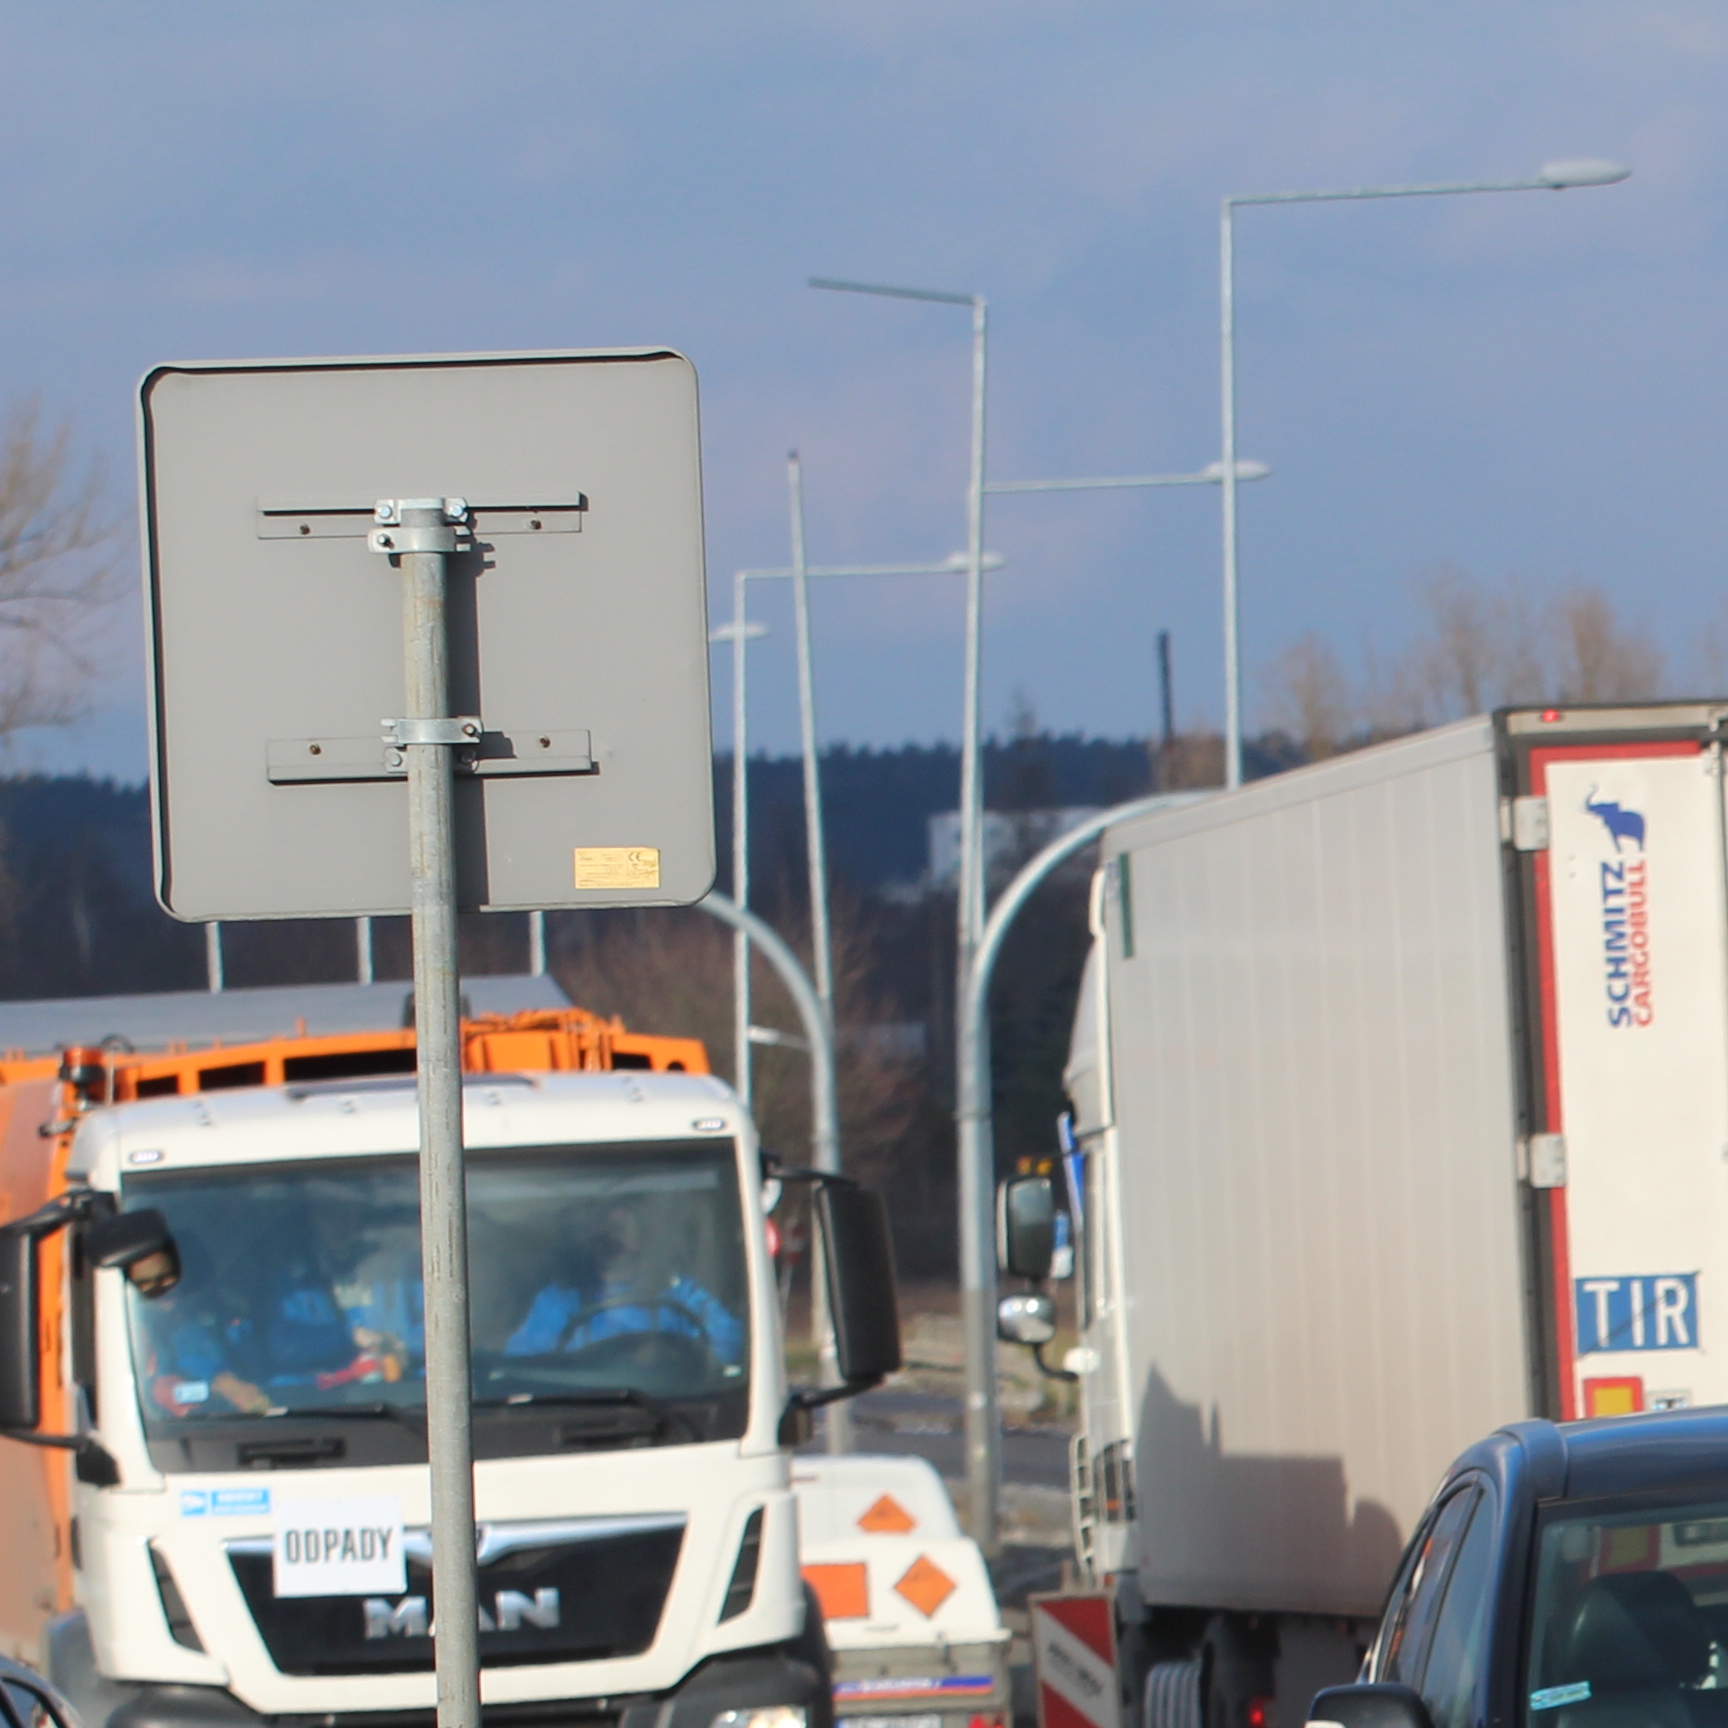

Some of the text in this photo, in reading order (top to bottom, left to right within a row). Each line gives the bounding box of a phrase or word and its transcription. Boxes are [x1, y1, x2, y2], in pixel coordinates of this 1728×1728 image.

[1601, 860, 1632, 1028] SCHMITZ
[1628, 859, 1655, 1028] CARGOBULL
[1582, 1278, 1690, 1347] TIR
[285, 1526, 393, 1564] ODPADY
